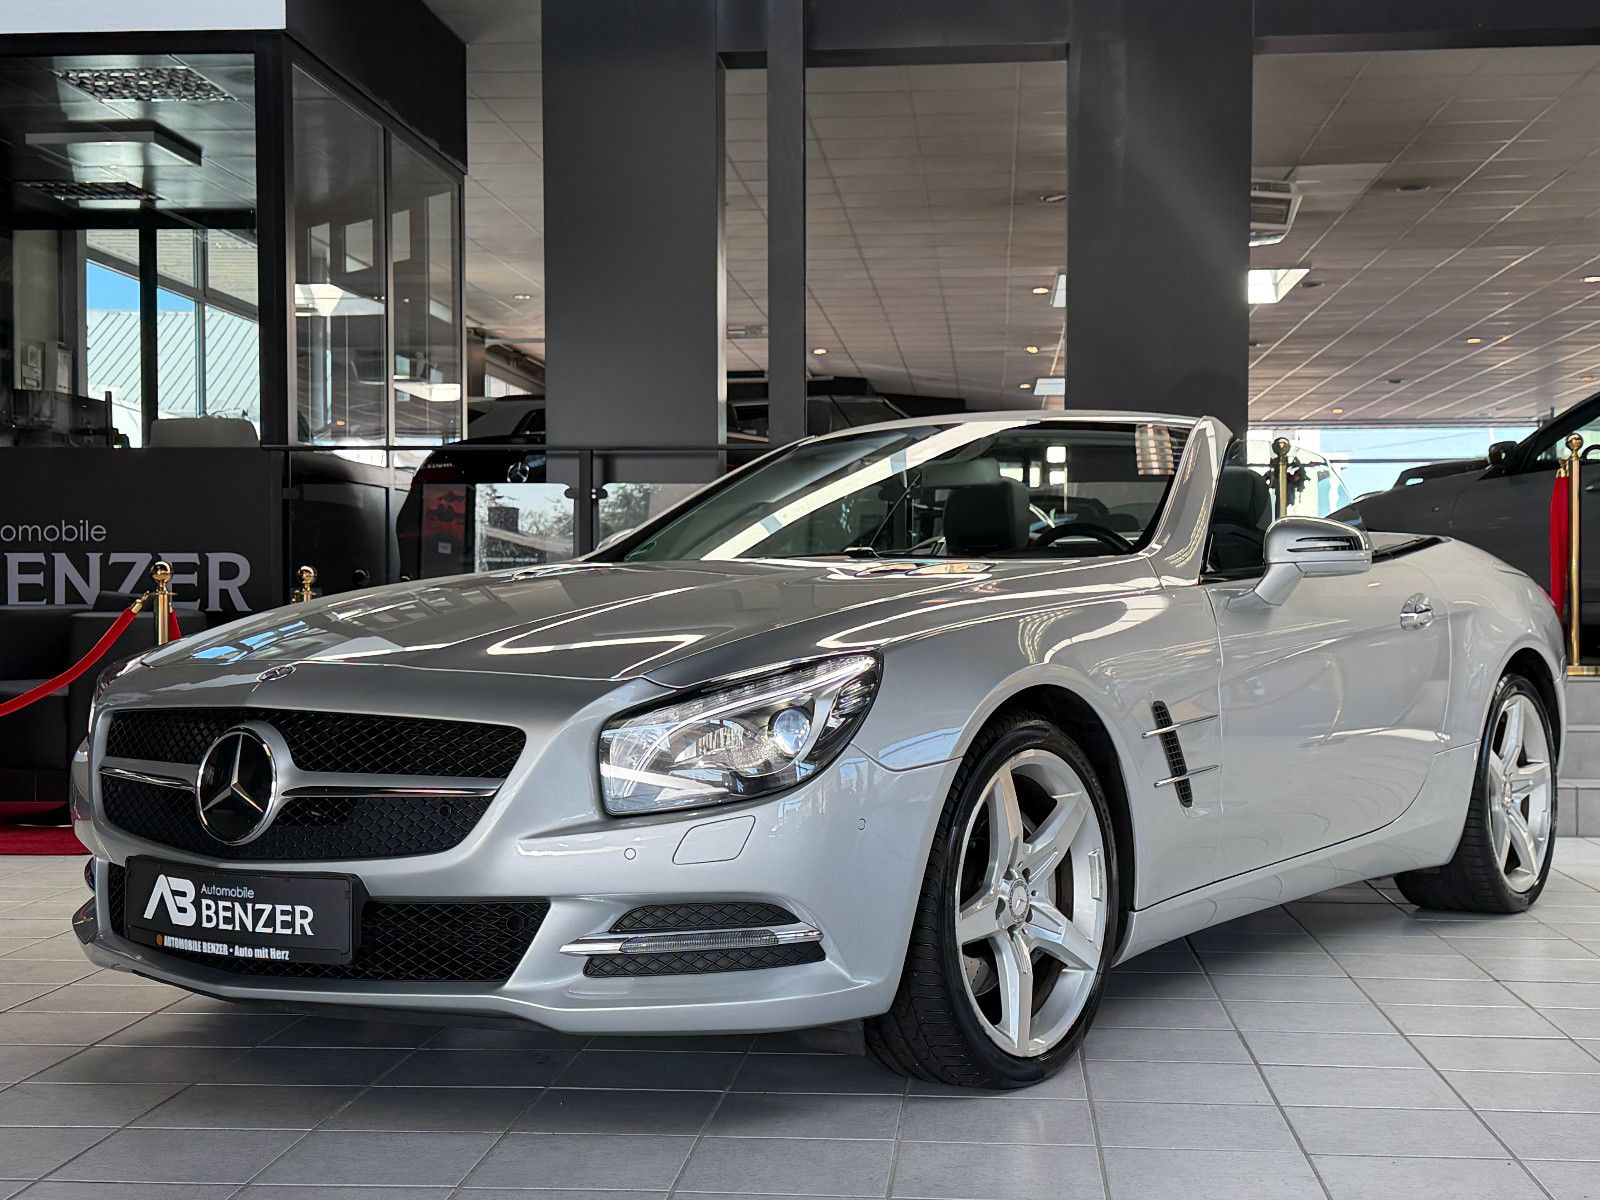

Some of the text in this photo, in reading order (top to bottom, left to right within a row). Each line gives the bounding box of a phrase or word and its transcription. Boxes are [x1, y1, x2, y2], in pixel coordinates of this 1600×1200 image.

[200, 883, 254, 899] Automobile
[201, 899, 315, 936] BENZER
[163, 935, 290, 961] AUTOMOBILE BENZER Auto mit Herz
